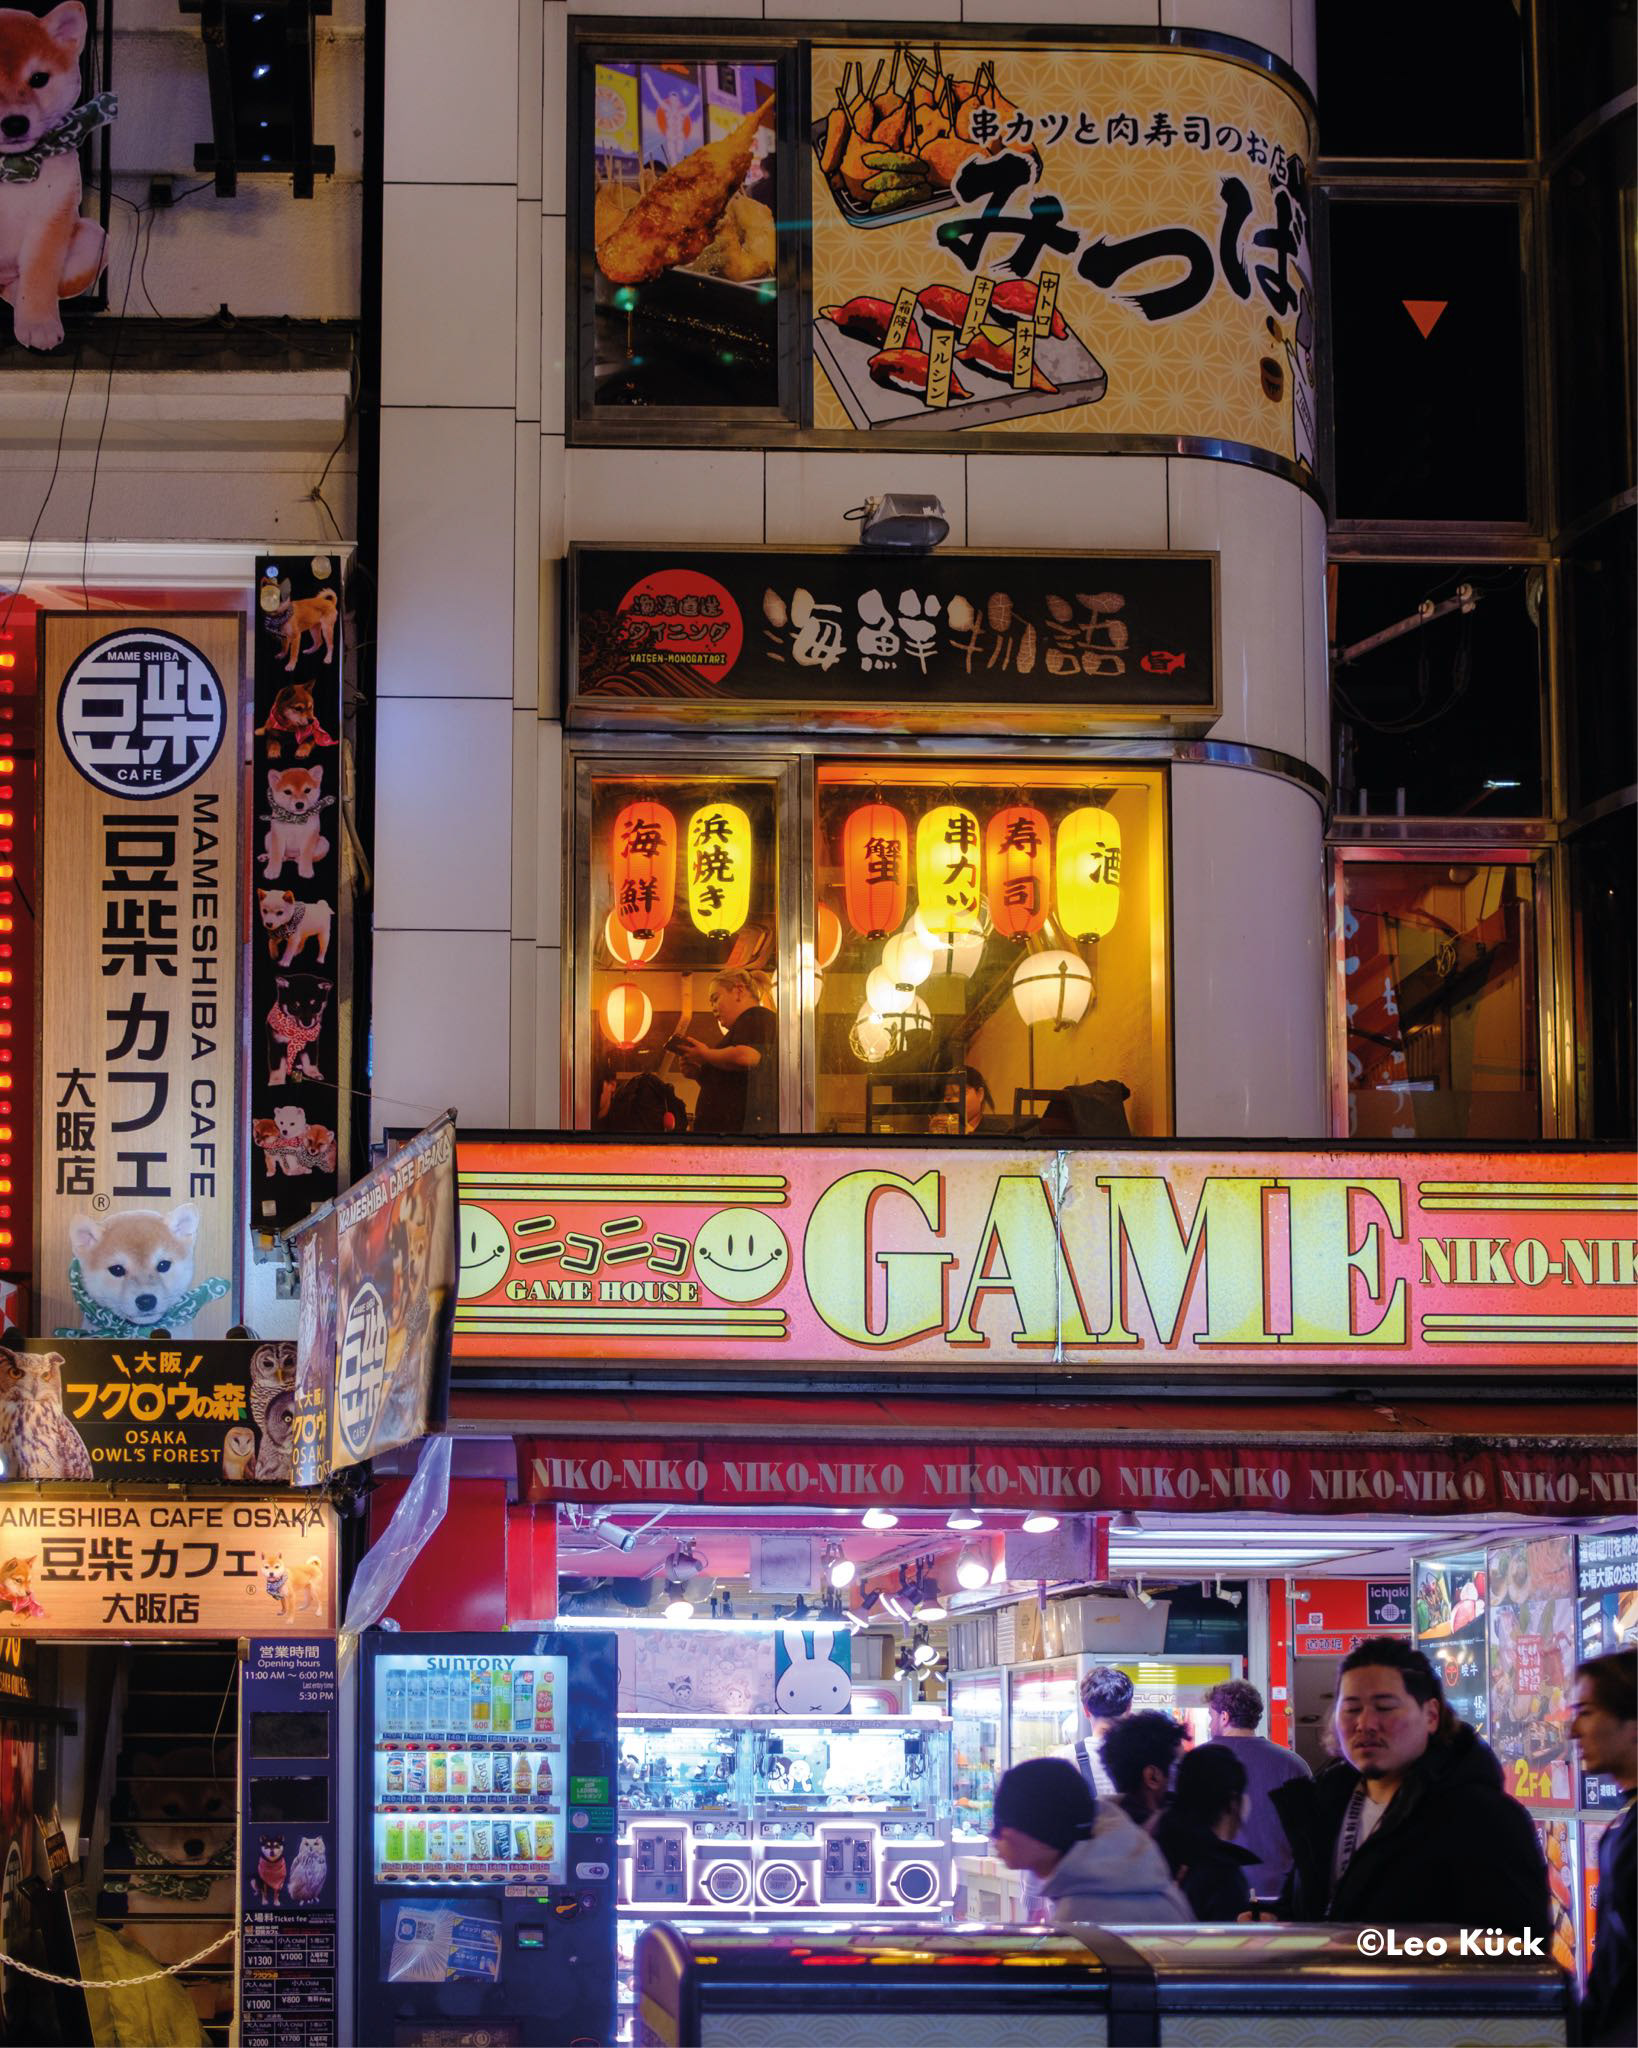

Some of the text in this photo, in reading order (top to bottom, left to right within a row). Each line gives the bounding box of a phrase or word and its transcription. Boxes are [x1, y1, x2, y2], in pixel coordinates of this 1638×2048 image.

[971, 109, 1289, 180] 串カツと肉寿司のお店
[937, 153, 1304, 320] みつば
[965, 281, 990, 336] 牛ロース
[1036, 278, 1057, 326] 中トロ
[892, 300, 913, 344] 霜降り
[930, 335, 951, 399] マルシン
[1017, 327, 1033, 376] 牛タン
[628, 621, 731, 643] ダイニング
[763, 587, 1130, 675] 海鮮物語
[107, 650, 180, 662] MAME SHIBA
[630, 653, 726, 664] KAISEN-MONOGATARI
[62, 661, 221, 765] 豆柴
[620, 818, 667, 916] 海鮮
[693, 813, 735, 917] 浜焼き
[864, 836, 901, 886] 蟹
[943, 813, 977, 917] 串カツ
[997, 816, 1042, 917] 寿司
[1089, 841, 1121, 885] 酒
[101, 814, 179, 1197] 豆柴カフェ
[190, 793, 219, 1198] MAMESHIBA CAFE
[56, 1067, 97, 1195] 大阪店
[389, 1160, 415, 1199] CAFE
[513, 1215, 692, 1276] ニコニコ
[803, 1169, 1410, 1350] GAME
[505, 1279, 700, 1303] GAME HOUSE
[134, 1351, 182, 1374] 大阪
[66, 1381, 249, 1421] フクロウの森
[91, 1447, 222, 1463] OWL'S FOREST
[125, 1430, 188, 1445] OSAKA
[530, 1457, 708, 1491] NIKO-NIKO
[721, 1461, 905, 1495] NIKO-NIKO
[923, 1463, 1101, 1497] NIKO-NIKO
[1119, 1465, 1291, 1500] NIKO-NIKO
[1309, 1467, 1486, 1501] NIKO-NIKO
[150, 1507, 224, 1528] CAFE
[233, 1507, 326, 1528] OSAKA
[40, 1537, 259, 1582] 豆柴カフェ
[101, 1593, 200, 1624] 大阪店
[257, 1659, 321, 1669] Opening hours
[260, 1645, 320, 1659] 営業時間
[245, 1671, 269, 1680] 11:00
[270, 1671, 285, 1679] AM
[299, 1671, 318, 1680] 6:00
[319, 1671, 334, 1679] PM
[299, 1692, 334, 1700] 5:30 PM
[1514, 1758, 1539, 1798] 2F
[244, 1912, 274, 1923] 入場料
[248, 1956, 273, 1966] ¥1300
[280, 1953, 303, 1961] ¥1000
[246, 1999, 271, 2010] ¥1000
[281, 1996, 301, 2004] ¥800
[248, 2038, 269, 2047] ¥2000
